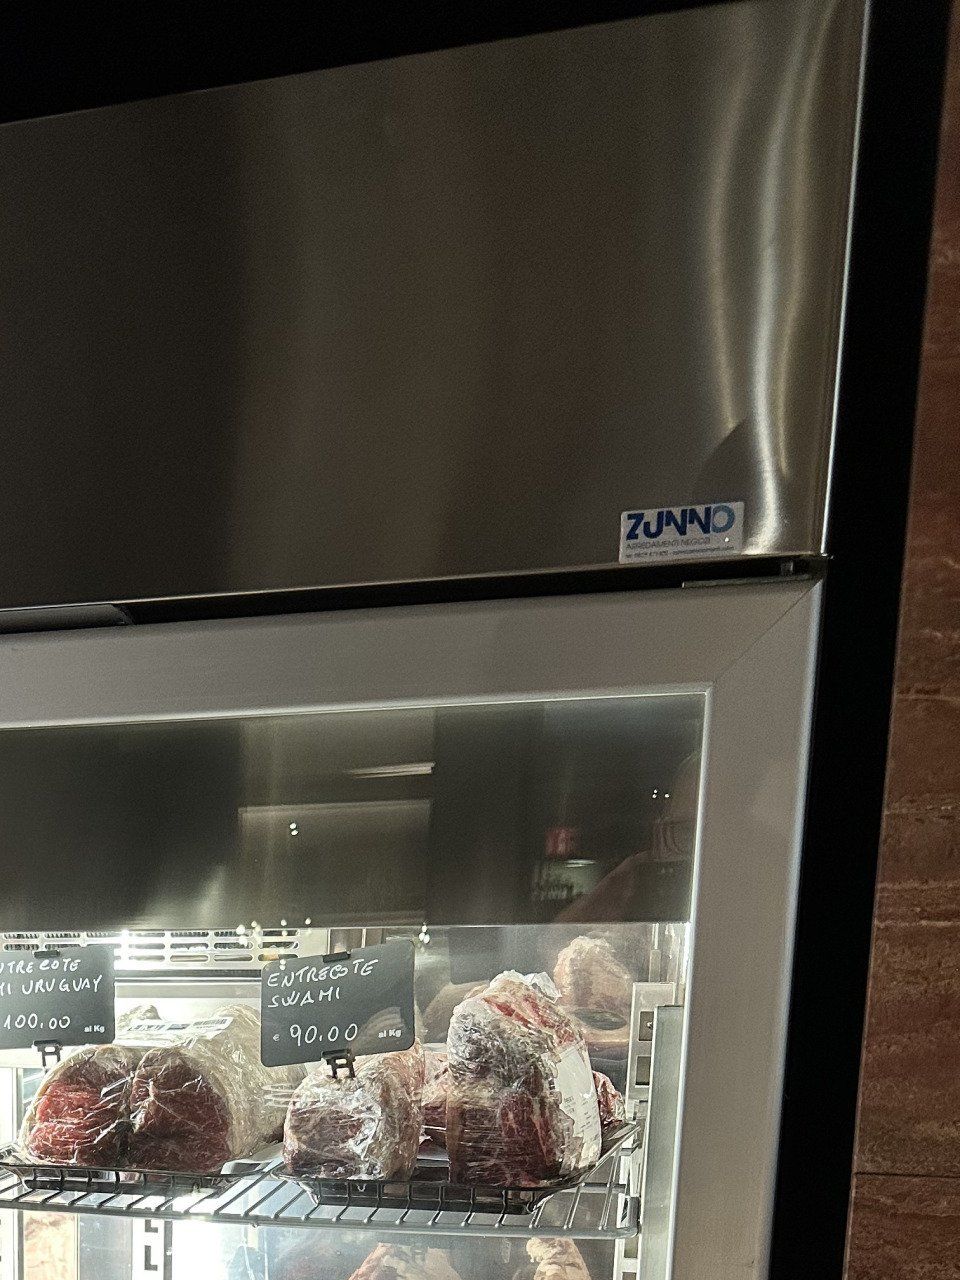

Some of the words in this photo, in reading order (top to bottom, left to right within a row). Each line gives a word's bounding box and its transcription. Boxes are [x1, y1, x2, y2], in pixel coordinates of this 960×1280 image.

[626, 504, 736, 541] ZUNNO
[267, 958, 379, 988] ENTRECOTE
[22, 974, 103, 996] URUGUAY
[267, 986, 341, 1008] SWAMI
[93, 1024, 106, 1033] Kg
[388, 1028, 402, 1039] Kg
